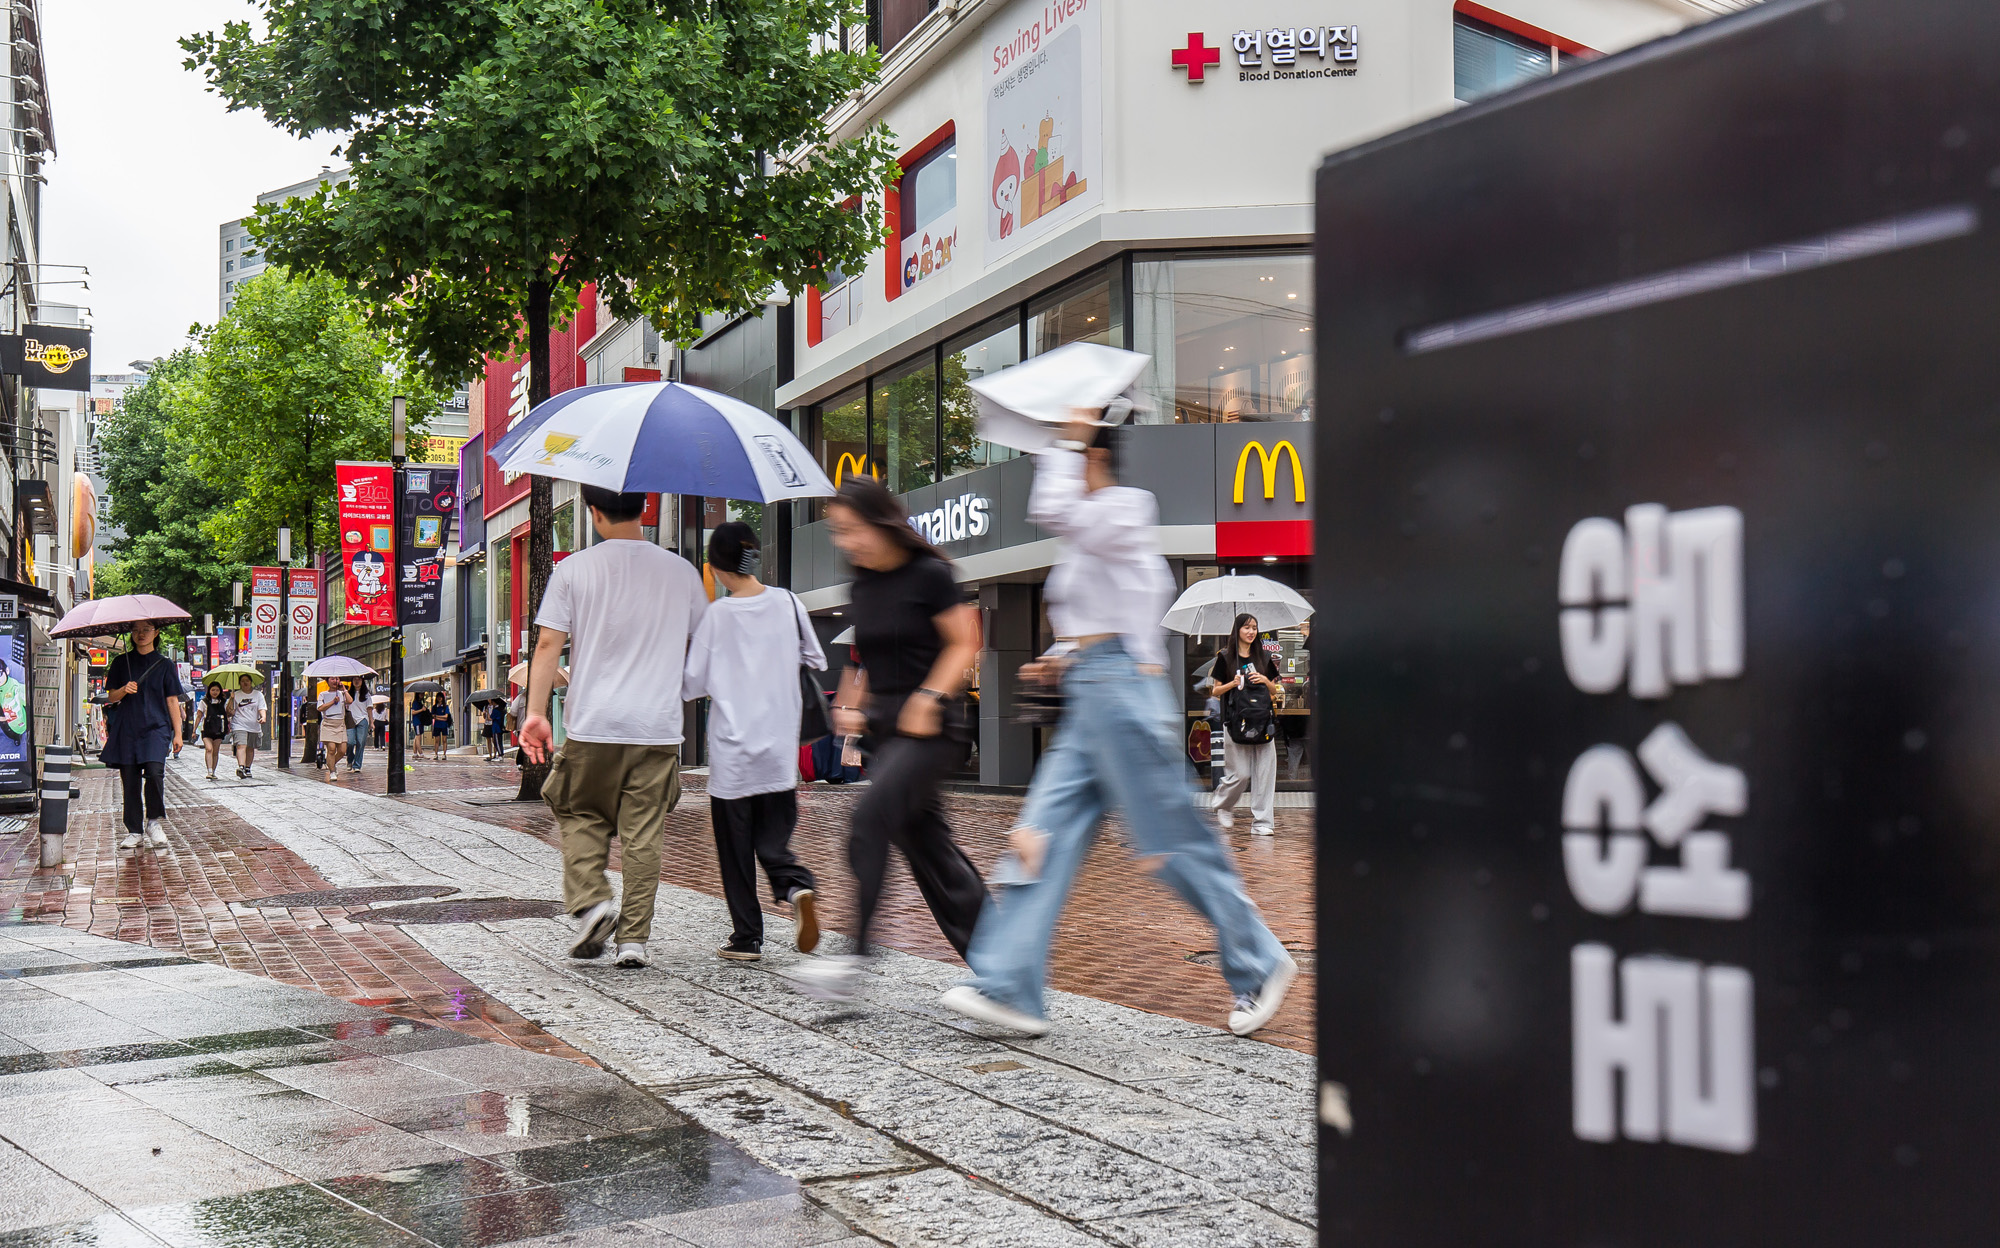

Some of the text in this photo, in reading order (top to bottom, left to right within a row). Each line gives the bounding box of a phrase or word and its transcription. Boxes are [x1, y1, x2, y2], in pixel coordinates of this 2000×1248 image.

[993, 21, 1040, 75] Saving
[1231, 24, 1358, 67] 헌혈의집
[1239, 67, 1358, 81] Blood Donation Center
[993, 76, 1016, 99] 적십자는
[25, 348, 88, 361] Martens
[256, 625, 276, 635] NO!
[293, 626, 313, 636] NO!
[1558, 503, 1758, 1155] 동성로
